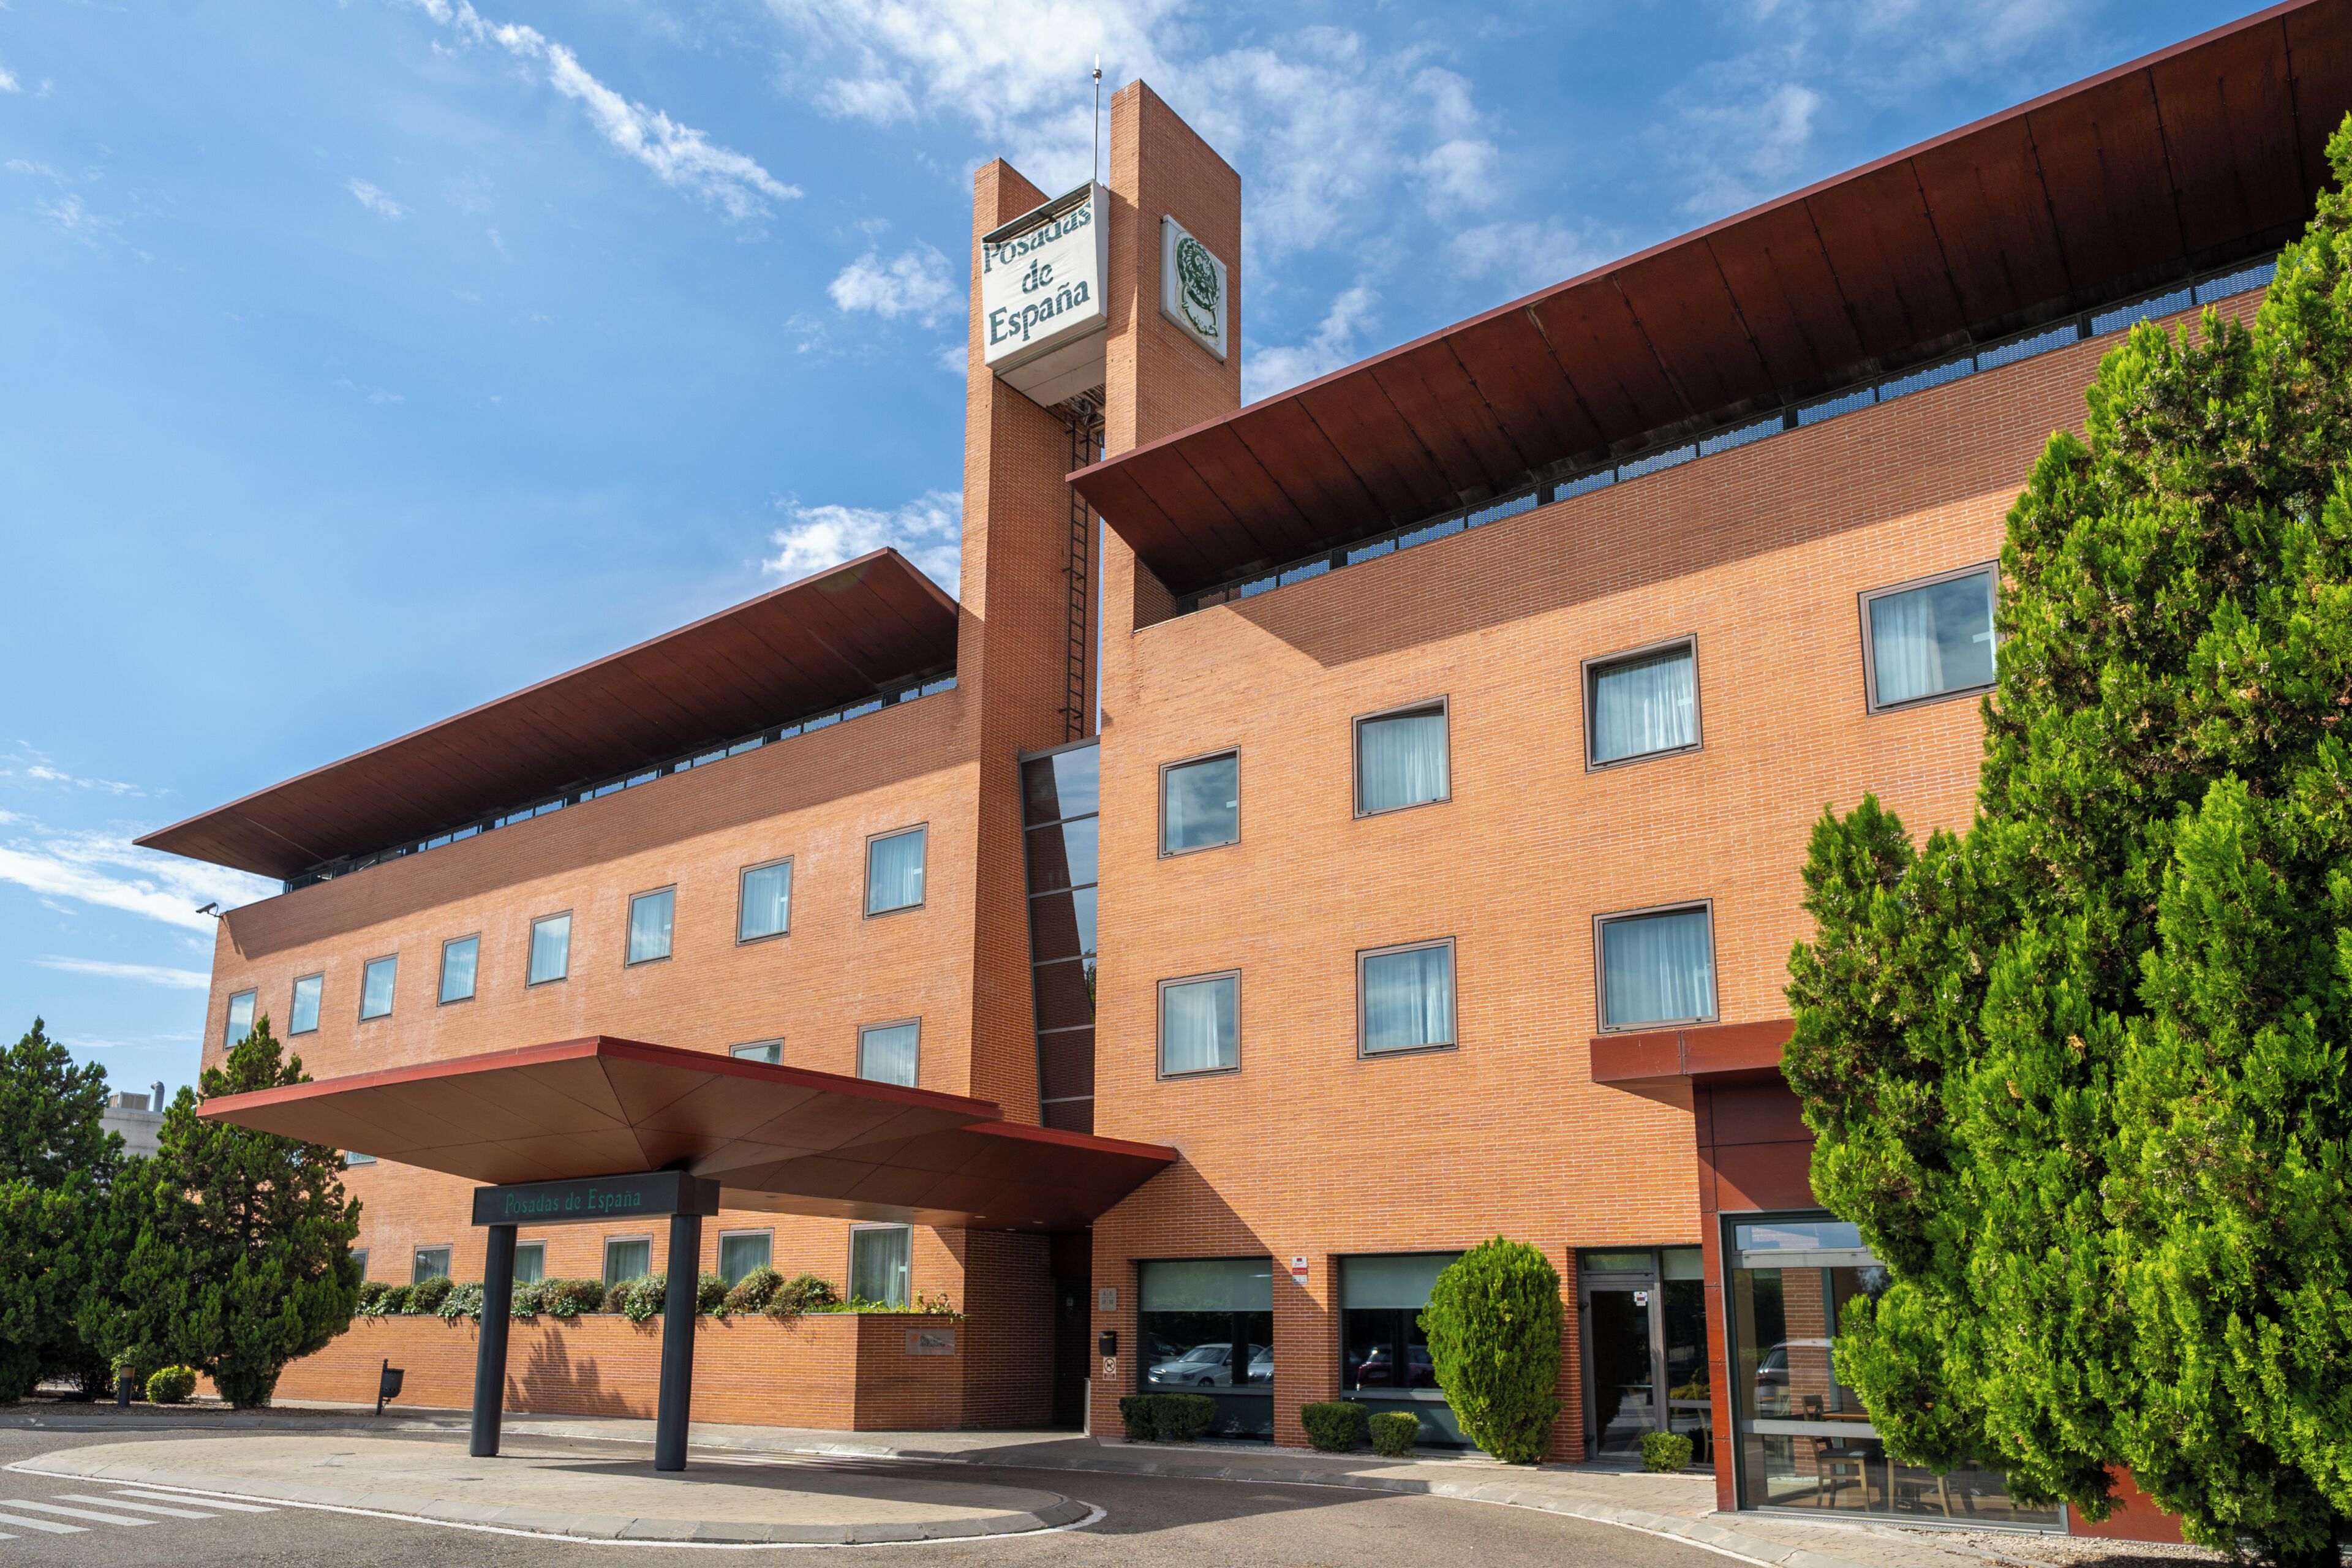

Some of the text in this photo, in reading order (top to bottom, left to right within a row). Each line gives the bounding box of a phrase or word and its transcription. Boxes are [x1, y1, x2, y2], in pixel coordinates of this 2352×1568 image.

[982, 202, 1091, 274] Posadas
[1022, 258, 1054, 295] de
[989, 282, 1090, 345] España
[505, 1188, 641, 1214] Posadas de España
